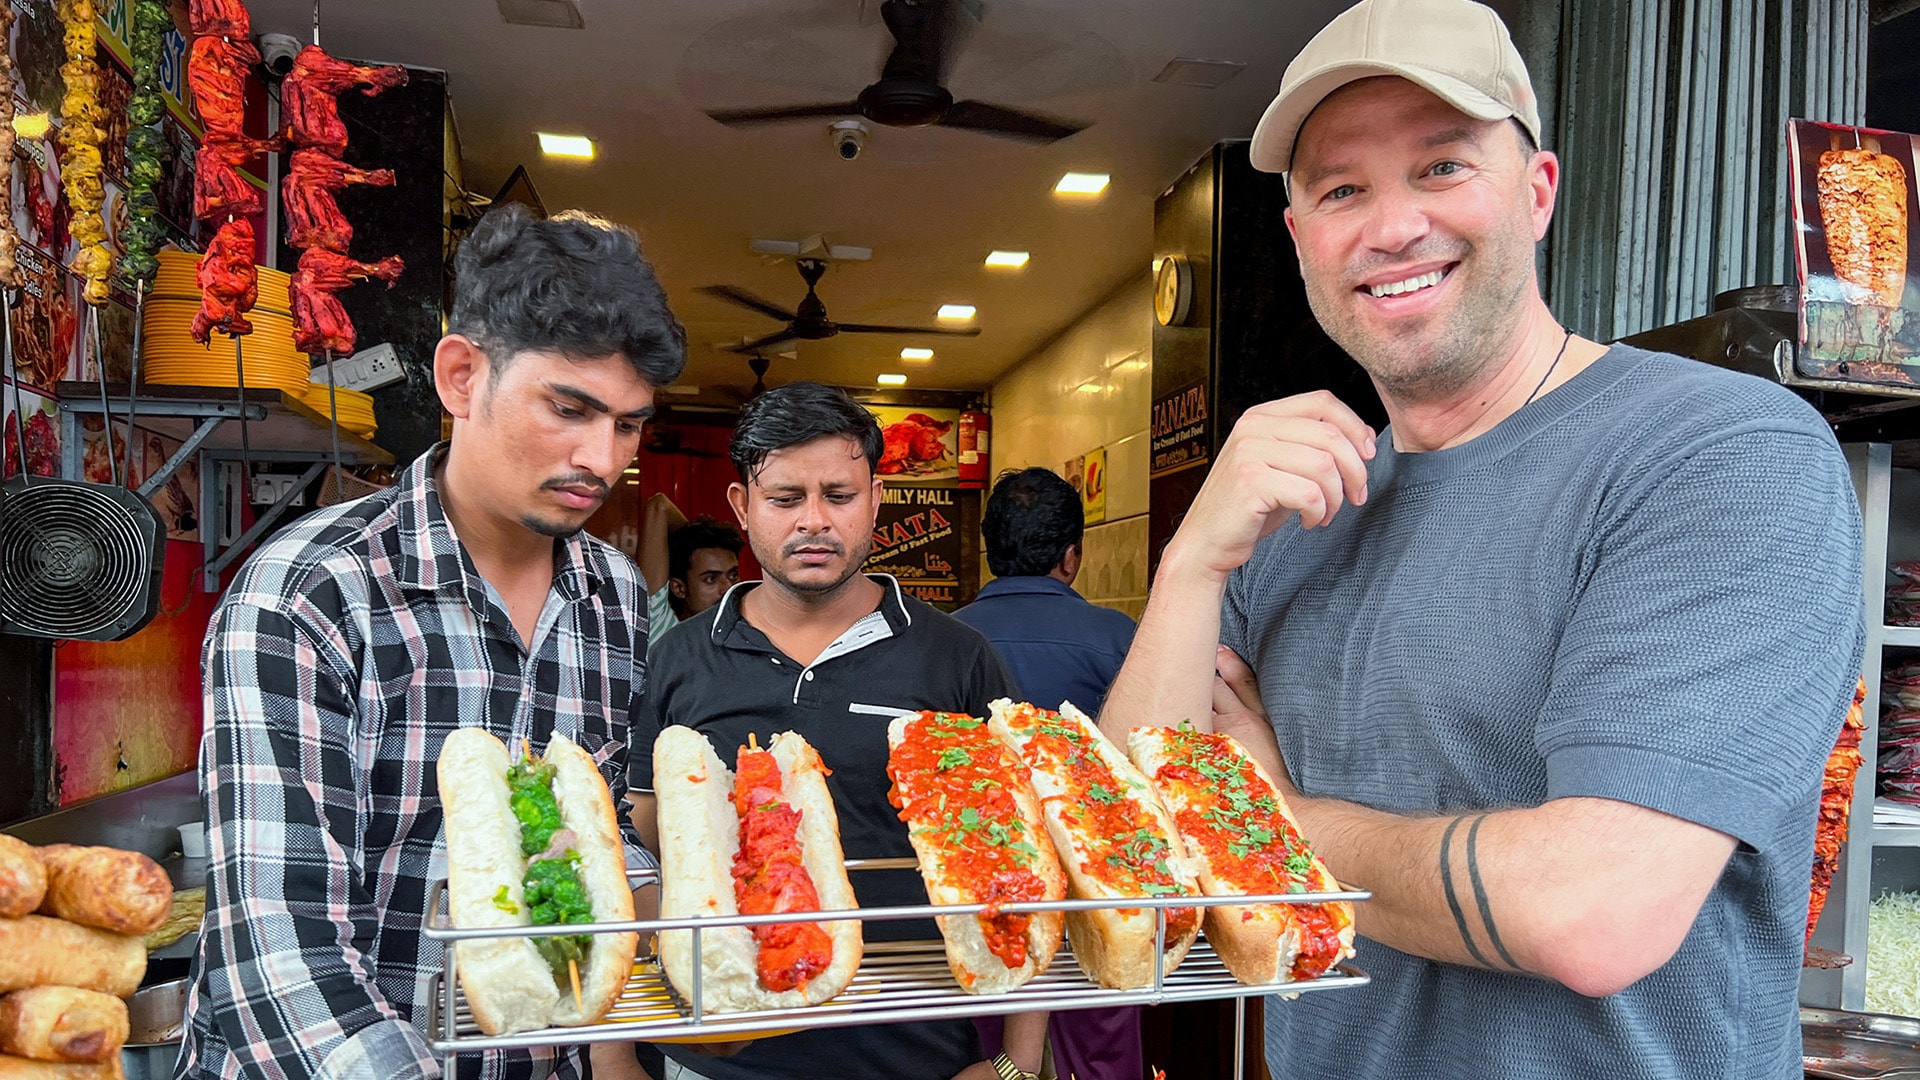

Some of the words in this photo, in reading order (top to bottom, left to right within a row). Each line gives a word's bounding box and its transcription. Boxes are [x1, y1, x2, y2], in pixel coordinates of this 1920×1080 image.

[15, 249, 43, 275] Chicken
[1152, 384, 1207, 439] JANATA
[1191, 424, 1204, 437] Food
[917, 490, 953, 505] HALL
[869, 508, 950, 554] NATA
[869, 548, 899, 564] Cream
[909, 536, 929, 549] Fast
[929, 527, 952, 540] Food
[917, 587, 953, 600] HALL
